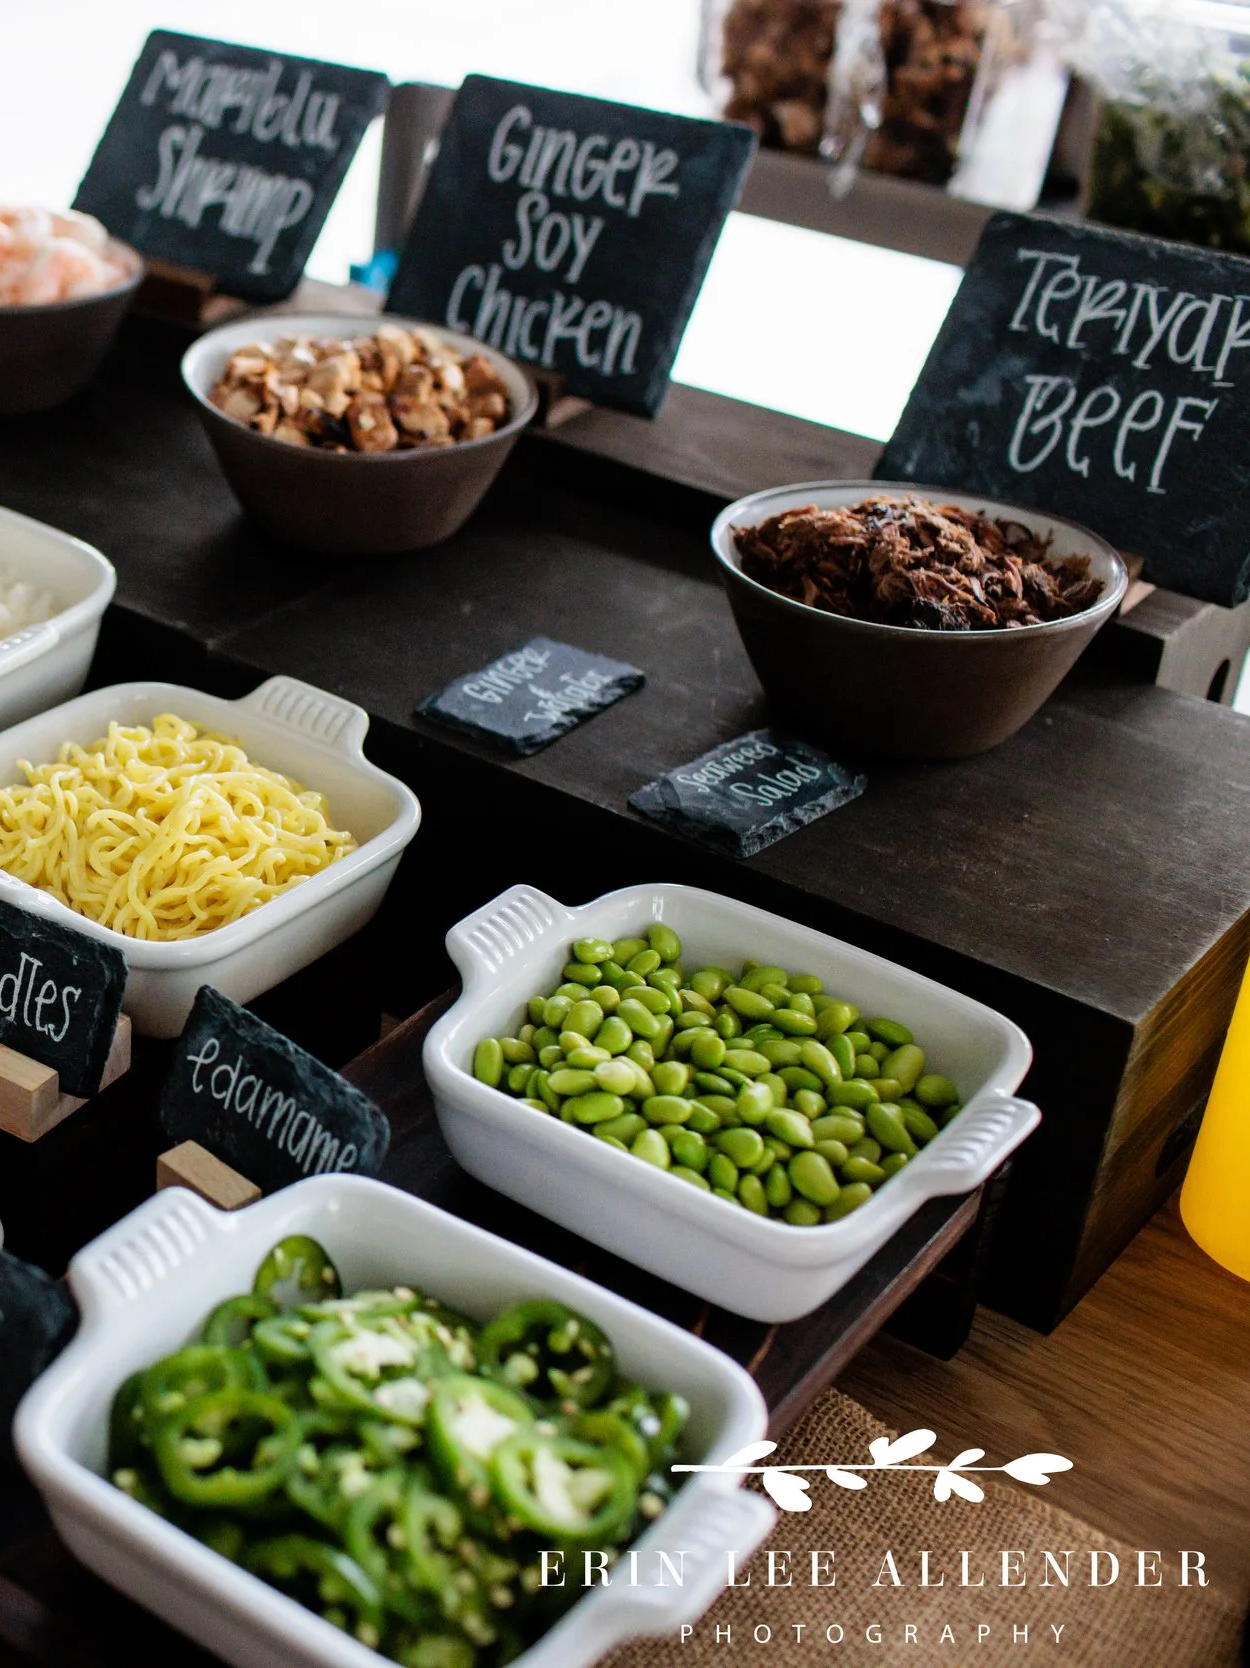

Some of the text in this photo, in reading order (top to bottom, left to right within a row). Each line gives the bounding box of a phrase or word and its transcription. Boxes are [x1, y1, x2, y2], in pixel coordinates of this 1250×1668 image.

[503, 190, 606, 284] Soy
[446, 263, 645, 378] Chicken
[729, 755, 821, 807] Salad
